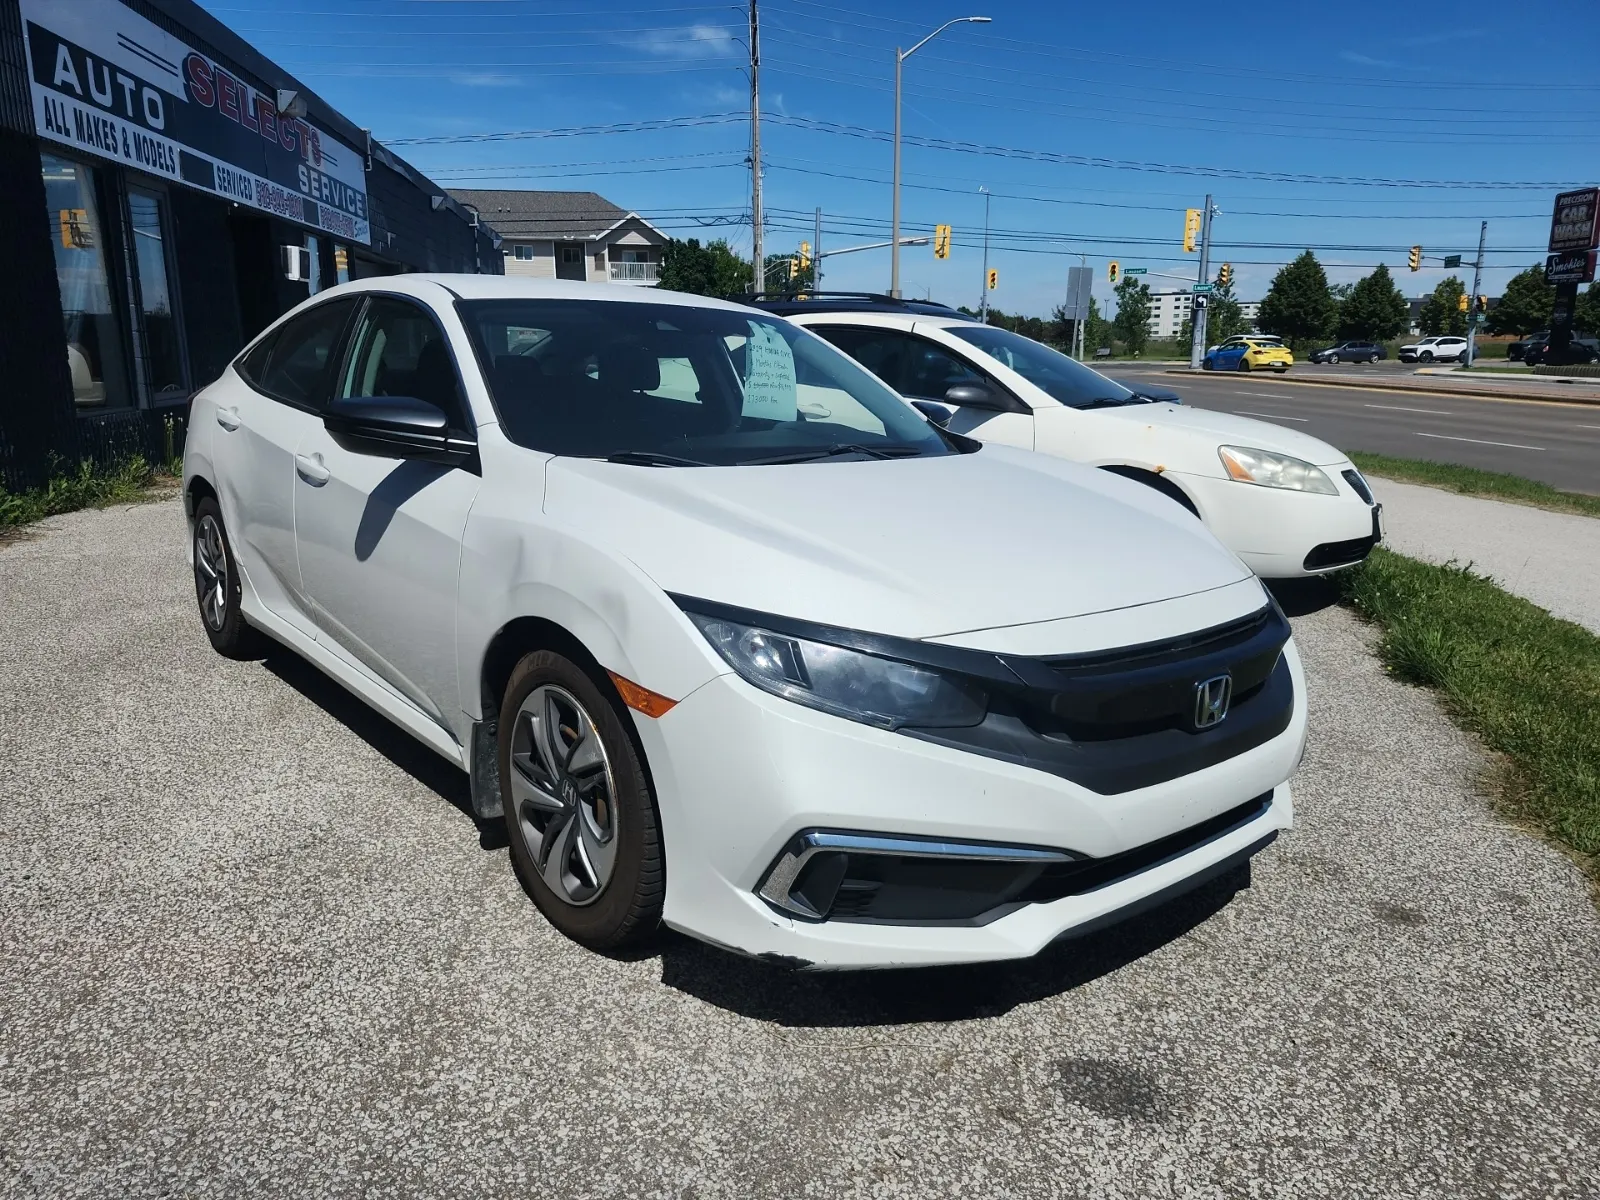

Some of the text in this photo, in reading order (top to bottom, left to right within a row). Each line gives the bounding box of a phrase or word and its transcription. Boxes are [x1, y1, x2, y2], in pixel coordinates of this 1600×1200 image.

[53, 42, 165, 130] AUTO
[184, 53, 322, 167] SELECTS
[44, 95, 176, 175] ALL MAKES & MODELS
[216, 165, 253, 201] SERVICED
[298, 164, 364, 217] SERVICE
[1560, 192, 1595, 205] PRECISION
[1553, 220, 1593, 241] WASH
[1560, 204, 1589, 224] CAR
